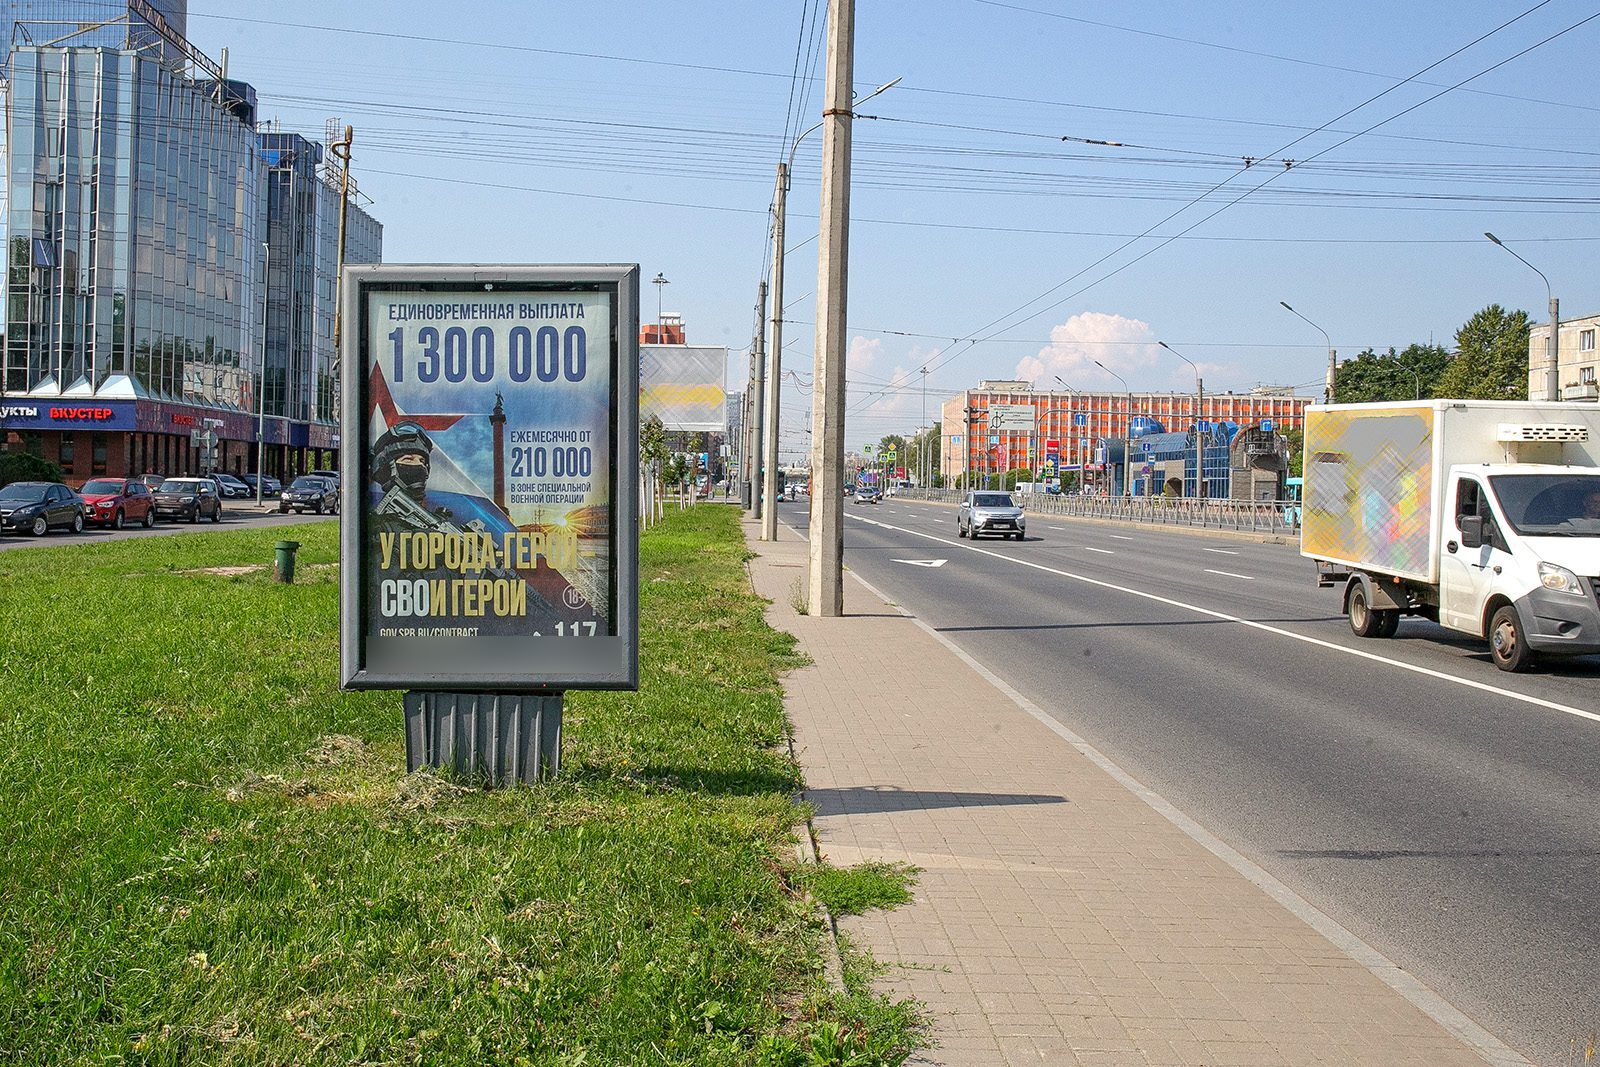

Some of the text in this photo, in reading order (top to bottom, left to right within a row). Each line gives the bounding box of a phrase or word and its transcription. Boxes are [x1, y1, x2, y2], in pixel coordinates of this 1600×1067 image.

[389, 303, 585, 321] ЕДИНОВРЕМЕННАЯ ВЫПЛАТА
[388, 325, 587, 383] 1 300 000
[0, 406, 112, 419] укты ВКУСТЕР
[510, 430, 592, 443] ЕЖЕМЕСЯЧНО ОТ
[510, 446, 592, 478] 210 000
[510, 482, 592, 493] В ЗОНЕ СПЕЦИАЛЬНОЙ
[510, 493, 585, 504] ВОЕННОЙ ОПЕРАЦИИ
[380, 532, 395, 570] У
[400, 531, 578, 574] ГОРОДА-ГЕРОЯ
[380, 579, 527, 617] СВОИ ГЕРОИ
